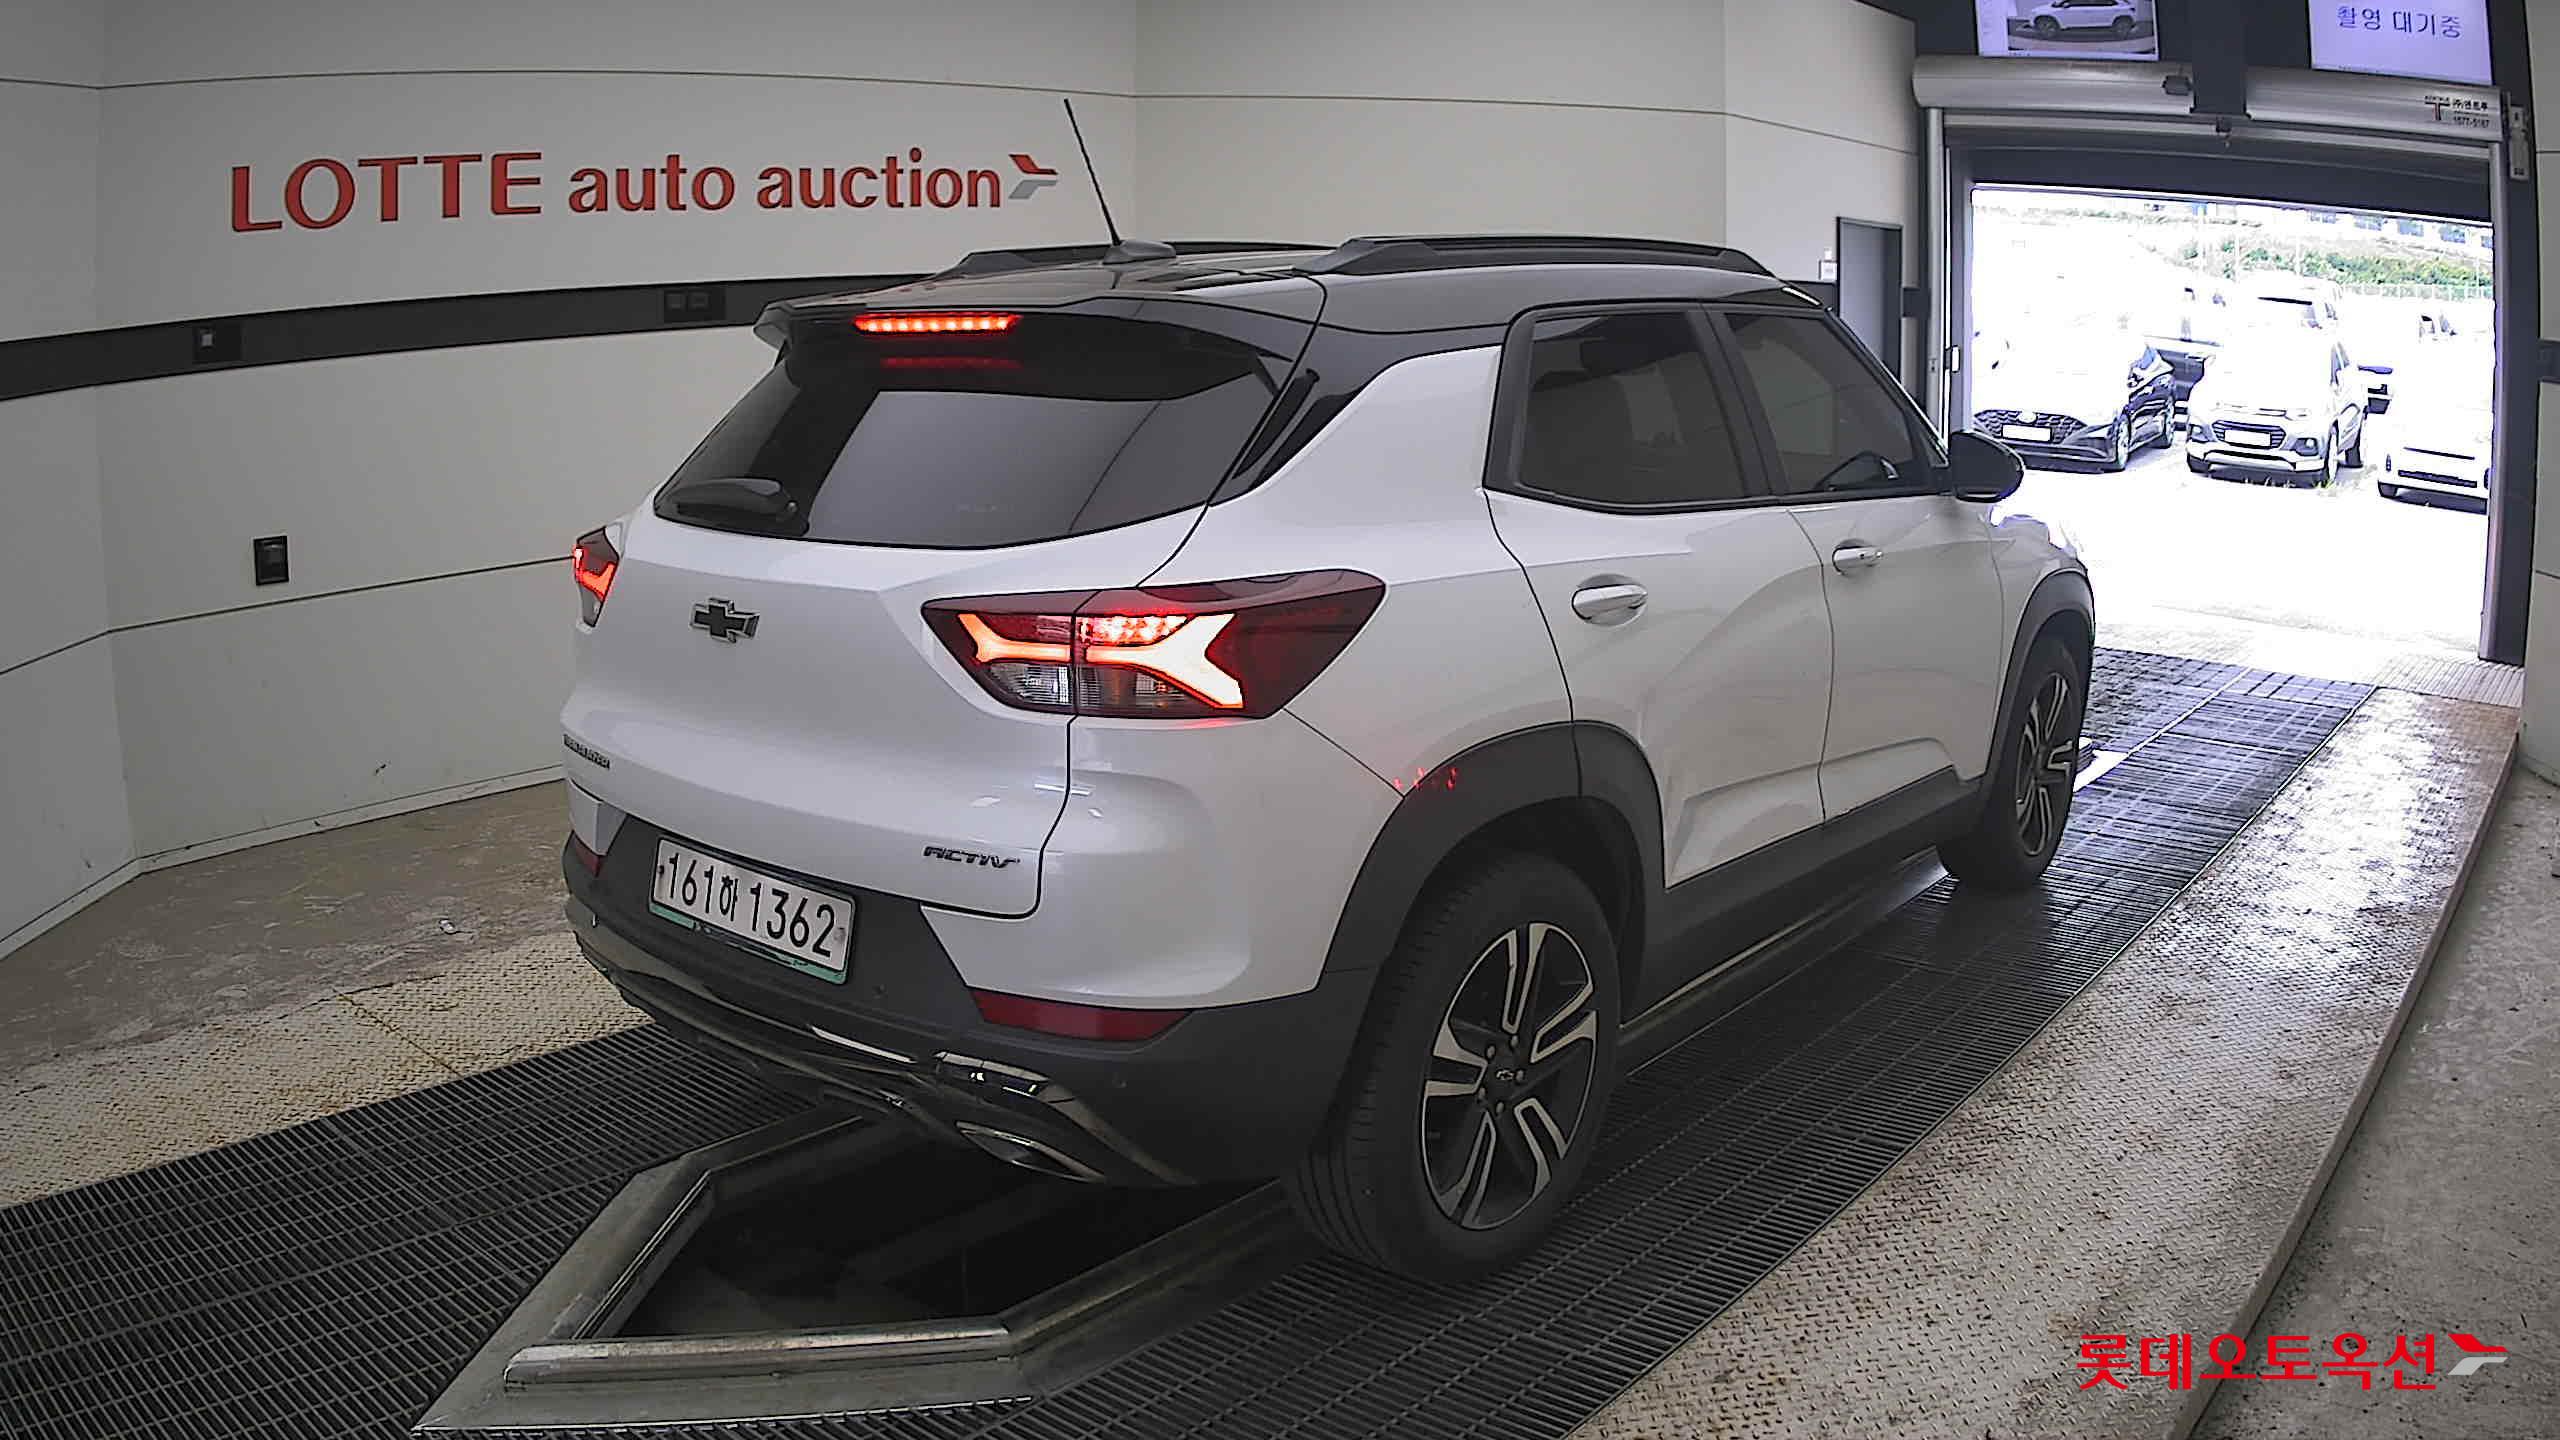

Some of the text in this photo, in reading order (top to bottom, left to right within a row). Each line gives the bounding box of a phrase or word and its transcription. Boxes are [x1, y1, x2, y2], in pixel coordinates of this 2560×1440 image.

[2337, 6, 2461, 39] 촬영 대기중
[232, 147, 1003, 233] LOTTE auto auction
[923, 846, 1020, 869] ACTIV
[668, 851, 836, 959] 161하 1362
